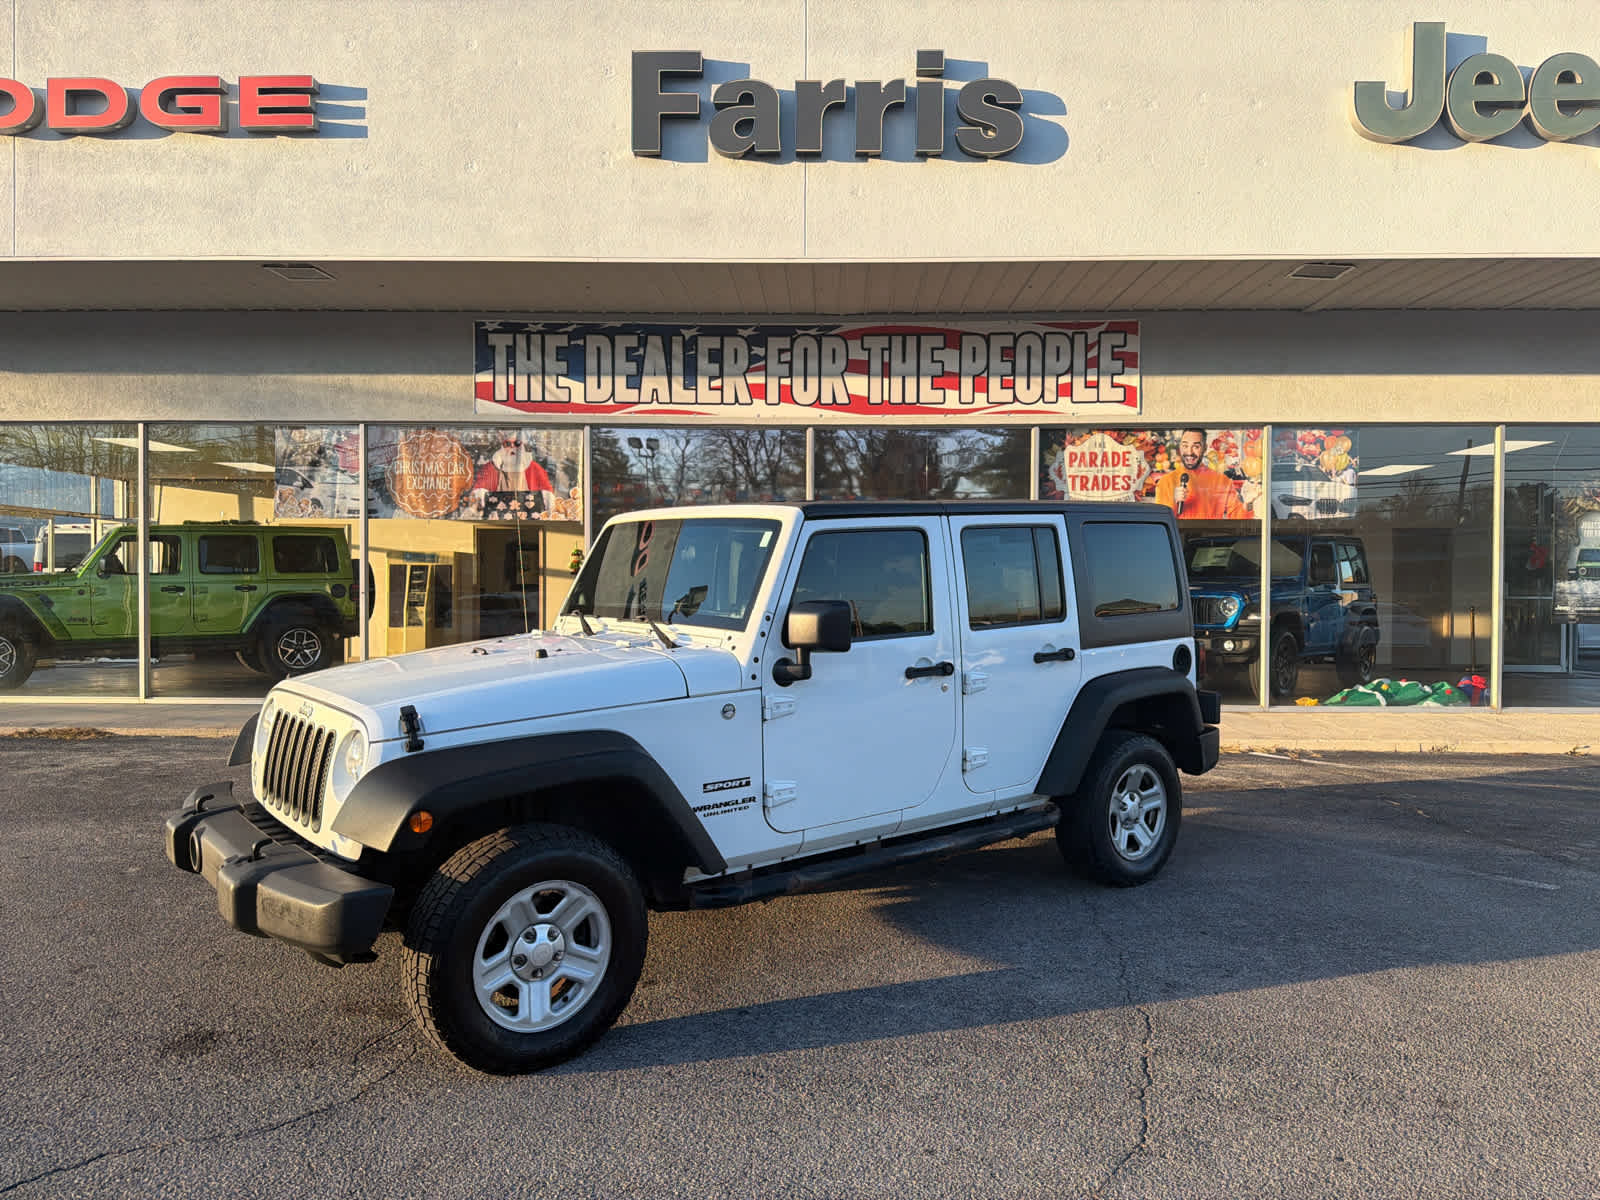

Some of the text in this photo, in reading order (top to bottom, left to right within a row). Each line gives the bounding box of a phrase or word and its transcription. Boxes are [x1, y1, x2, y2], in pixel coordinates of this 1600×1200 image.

[631, 49, 1025, 157] Farris
[488, 331, 1127, 406] THE DEALER FOR THE PEOPLE
[394, 461, 465, 475] CHRISTMAS CAR
[1068, 451, 1132, 468] PARADE
[406, 475, 452, 490] EXCHANGE
[1068, 474, 1132, 491] TRADES
[704, 778, 748, 792] SPORT
[692, 796, 757, 813] WRANGLER
[703, 805, 750, 818] UNLIMITED
